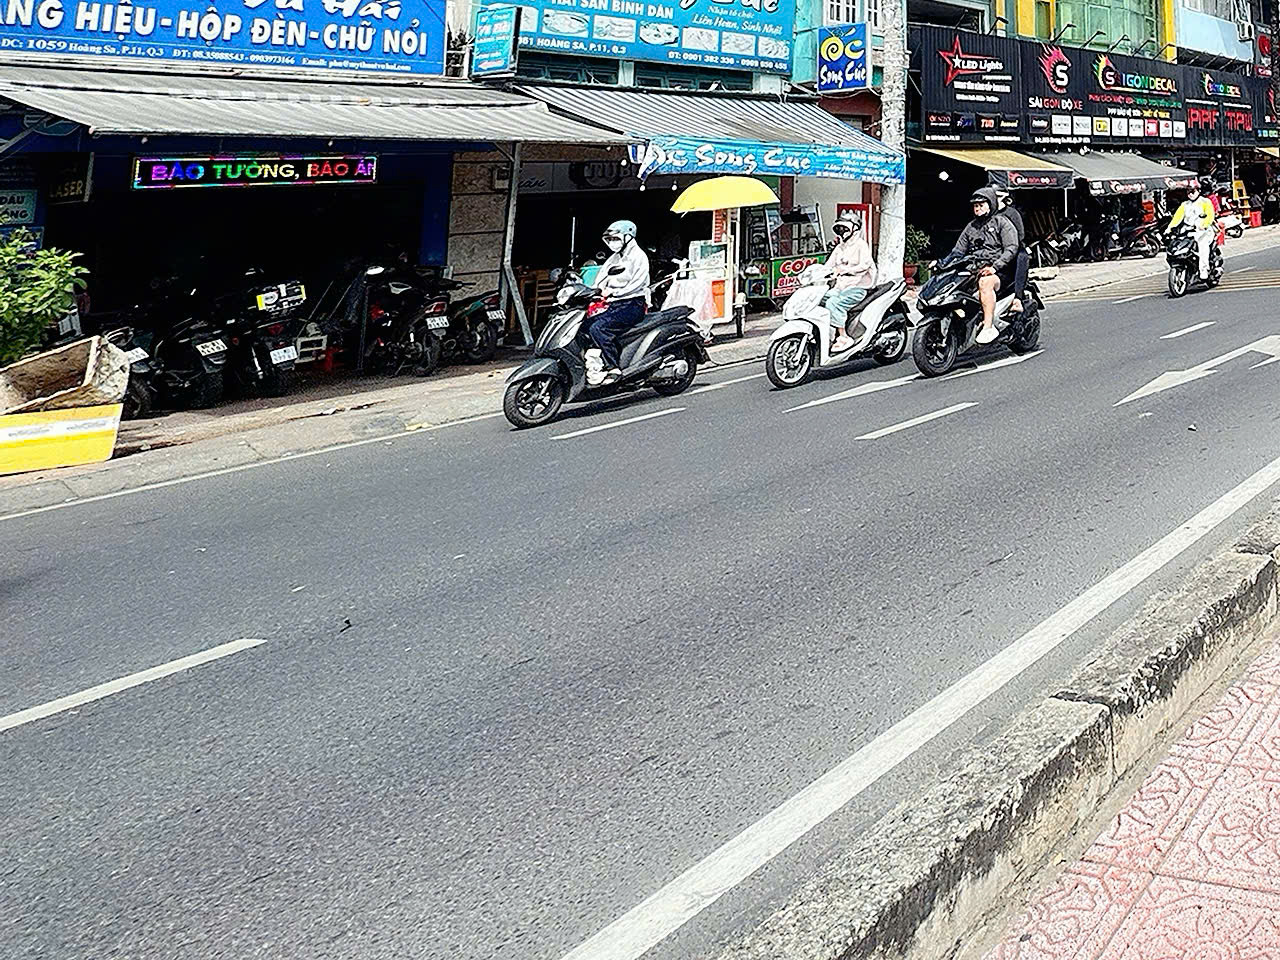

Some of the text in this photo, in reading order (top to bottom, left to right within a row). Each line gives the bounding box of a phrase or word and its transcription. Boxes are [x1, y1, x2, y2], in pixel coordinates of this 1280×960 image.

[27, 38, 68, 51] 1059
[961, 60, 979, 70] LED
[820, 64, 844, 89] Song
[1187, 107, 1253, 132] PPF TPU
[694, 143, 759, 175] Song
[213, 161, 299, 180] TƯỜNG,
